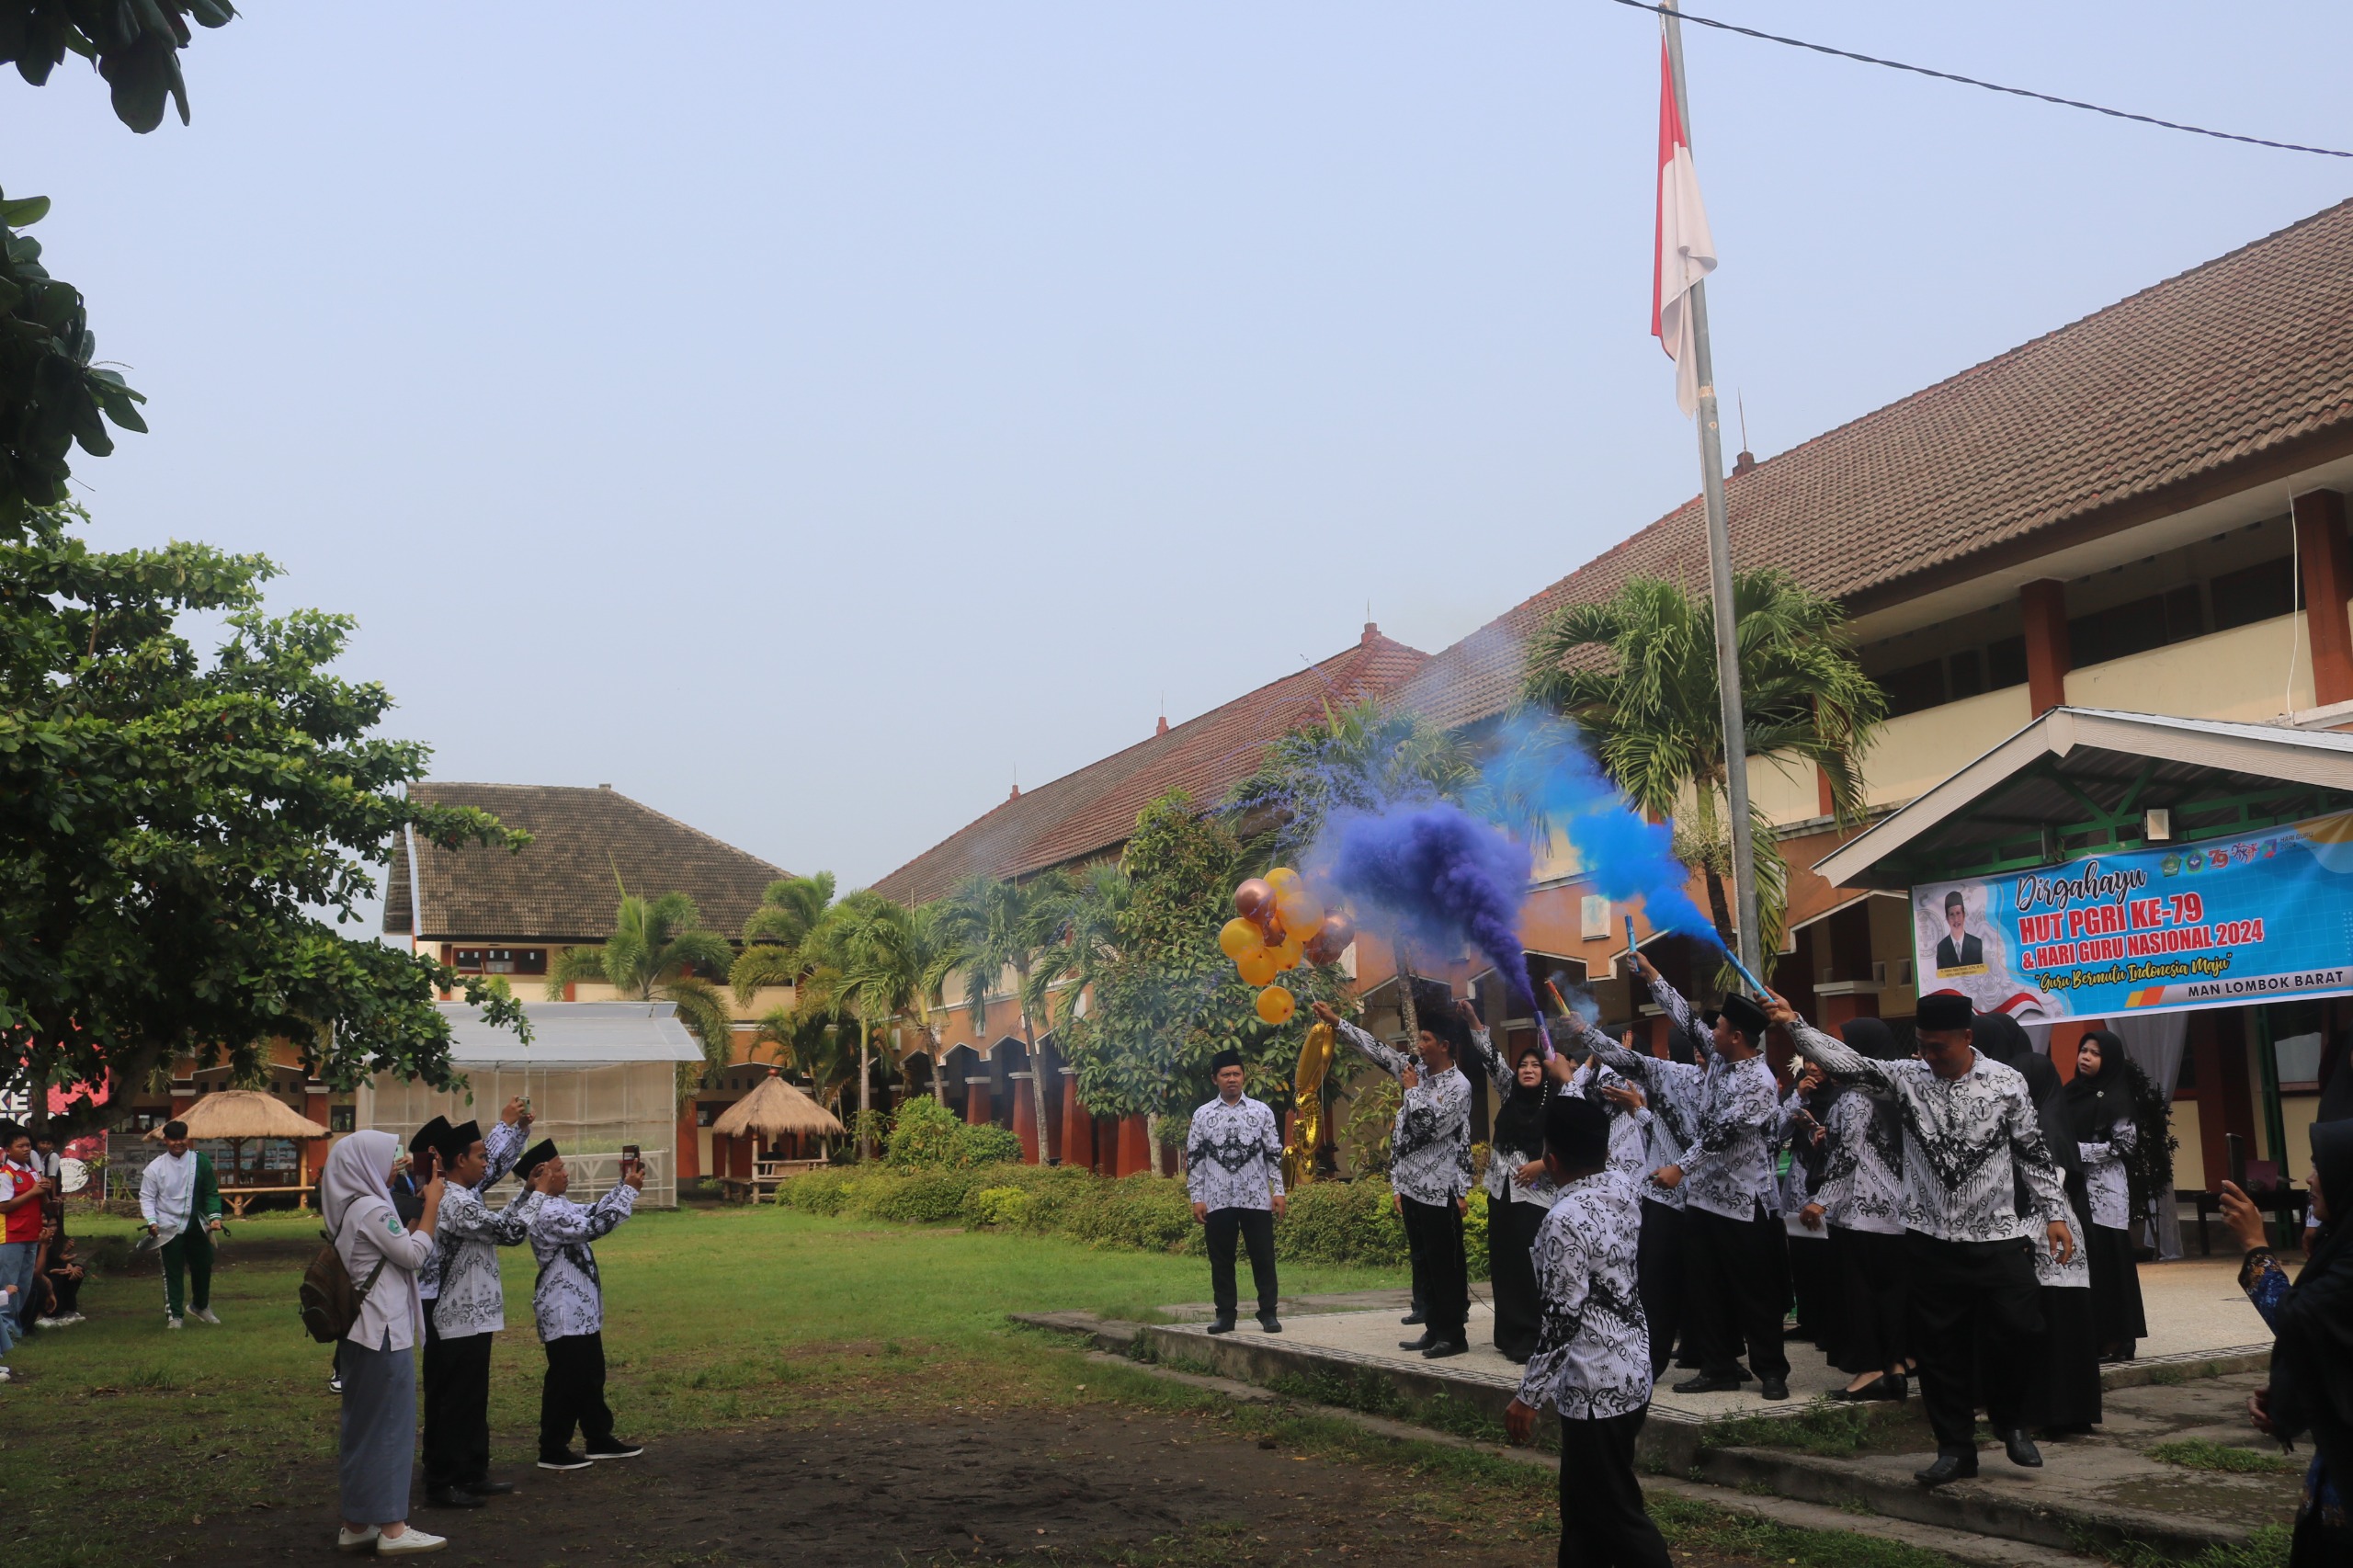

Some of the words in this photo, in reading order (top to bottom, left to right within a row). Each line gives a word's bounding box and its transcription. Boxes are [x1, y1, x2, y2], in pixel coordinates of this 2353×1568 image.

[2280, 835, 2295, 843] HARI
[2296, 831, 2313, 840] GURU
[2208, 848, 2230, 869] 79
[2016, 860, 2146, 912] Dirgahayu
[2018, 912, 2063, 945] HUT
[2068, 904, 2126, 937] PGRI
[2130, 892, 2203, 929] KE-79
[2022, 951, 2034, 971] &
[2035, 942, 2076, 969] HARI
[2077, 936, 2124, 964] GURU
[2126, 926, 2213, 958] NASIONAL
[2215, 917, 2264, 948] 2024
[2073, 963, 2126, 989] Bermutu
[2127, 960, 2188, 983] Indonesia
[2188, 984, 2221, 998] MAN
[2225, 976, 2290, 994] LOMBOK
[2294, 971, 2344, 987] BARAT
